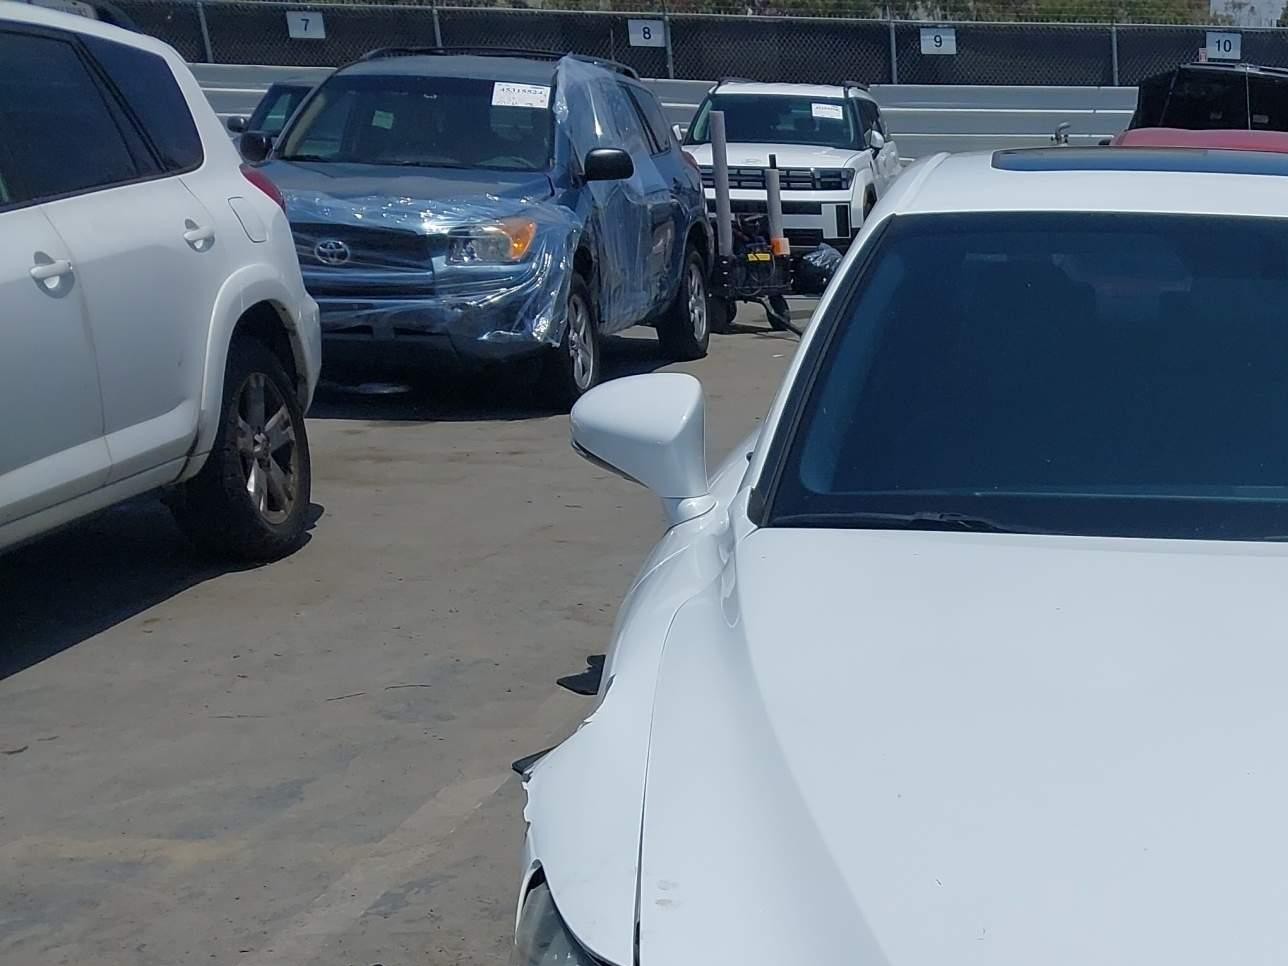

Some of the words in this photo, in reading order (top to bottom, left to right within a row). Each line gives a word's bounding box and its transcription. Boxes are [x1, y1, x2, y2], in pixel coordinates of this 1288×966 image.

[300, 18, 310, 32] 7
[642, 26, 652, 40] 8
[933, 34, 943, 48] 9
[1215, 39, 1232, 53] 10
